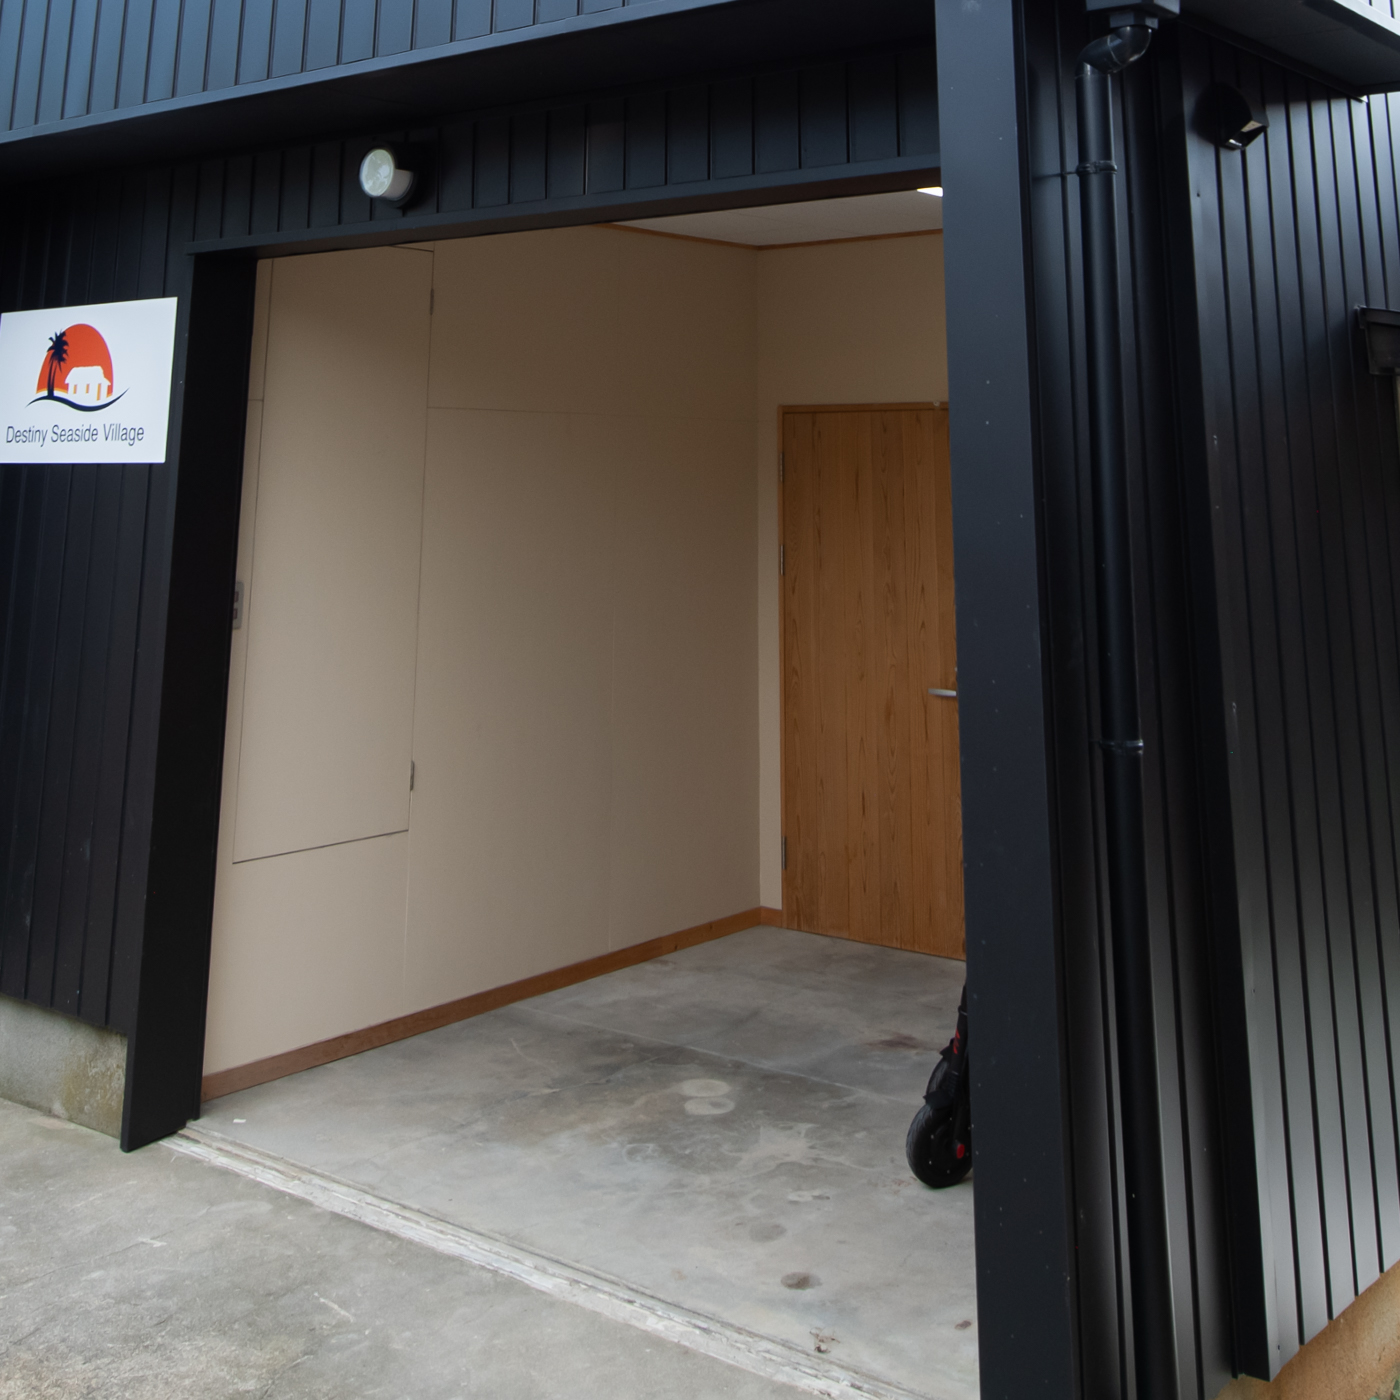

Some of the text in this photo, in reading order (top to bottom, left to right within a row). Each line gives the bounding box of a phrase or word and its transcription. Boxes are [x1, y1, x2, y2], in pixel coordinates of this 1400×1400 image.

[6, 423, 145, 447] Destiny Seaside Village
